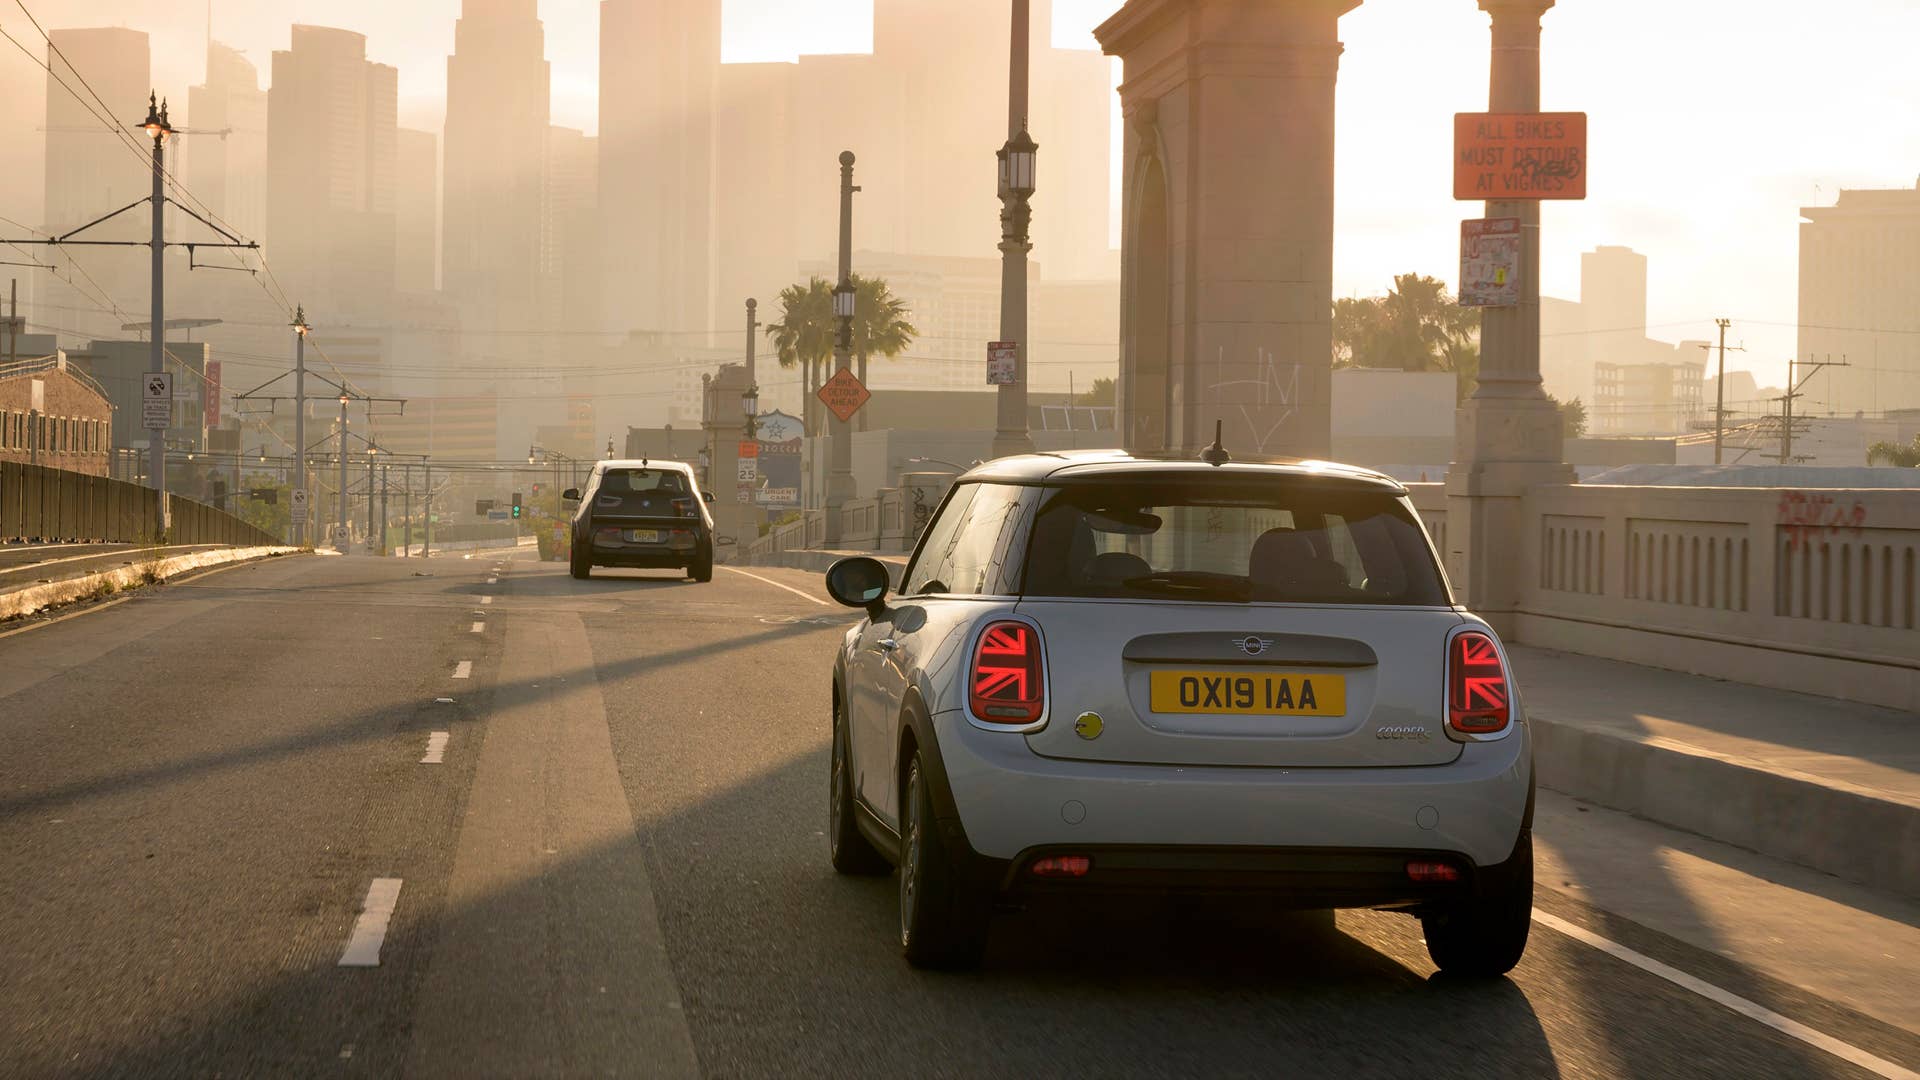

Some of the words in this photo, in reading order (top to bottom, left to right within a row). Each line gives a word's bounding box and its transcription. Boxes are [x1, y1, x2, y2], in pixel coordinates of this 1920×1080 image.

[1475, 121, 1507, 139] ALL
[1515, 121, 1565, 139] BIKES
[1460, 146, 1504, 165] MUST
[1514, 147, 1580, 166] DETOUR
[1475, 173, 1495, 192] AT
[1503, 172, 1565, 191] VIGNES
[828, 388, 859, 398] DETOUR
[740, 470, 755, 480] 25
[1180, 677, 1254, 708] OX19
[1265, 678, 1317, 710] IAA
[1376, 727, 1424, 739] COOPER
